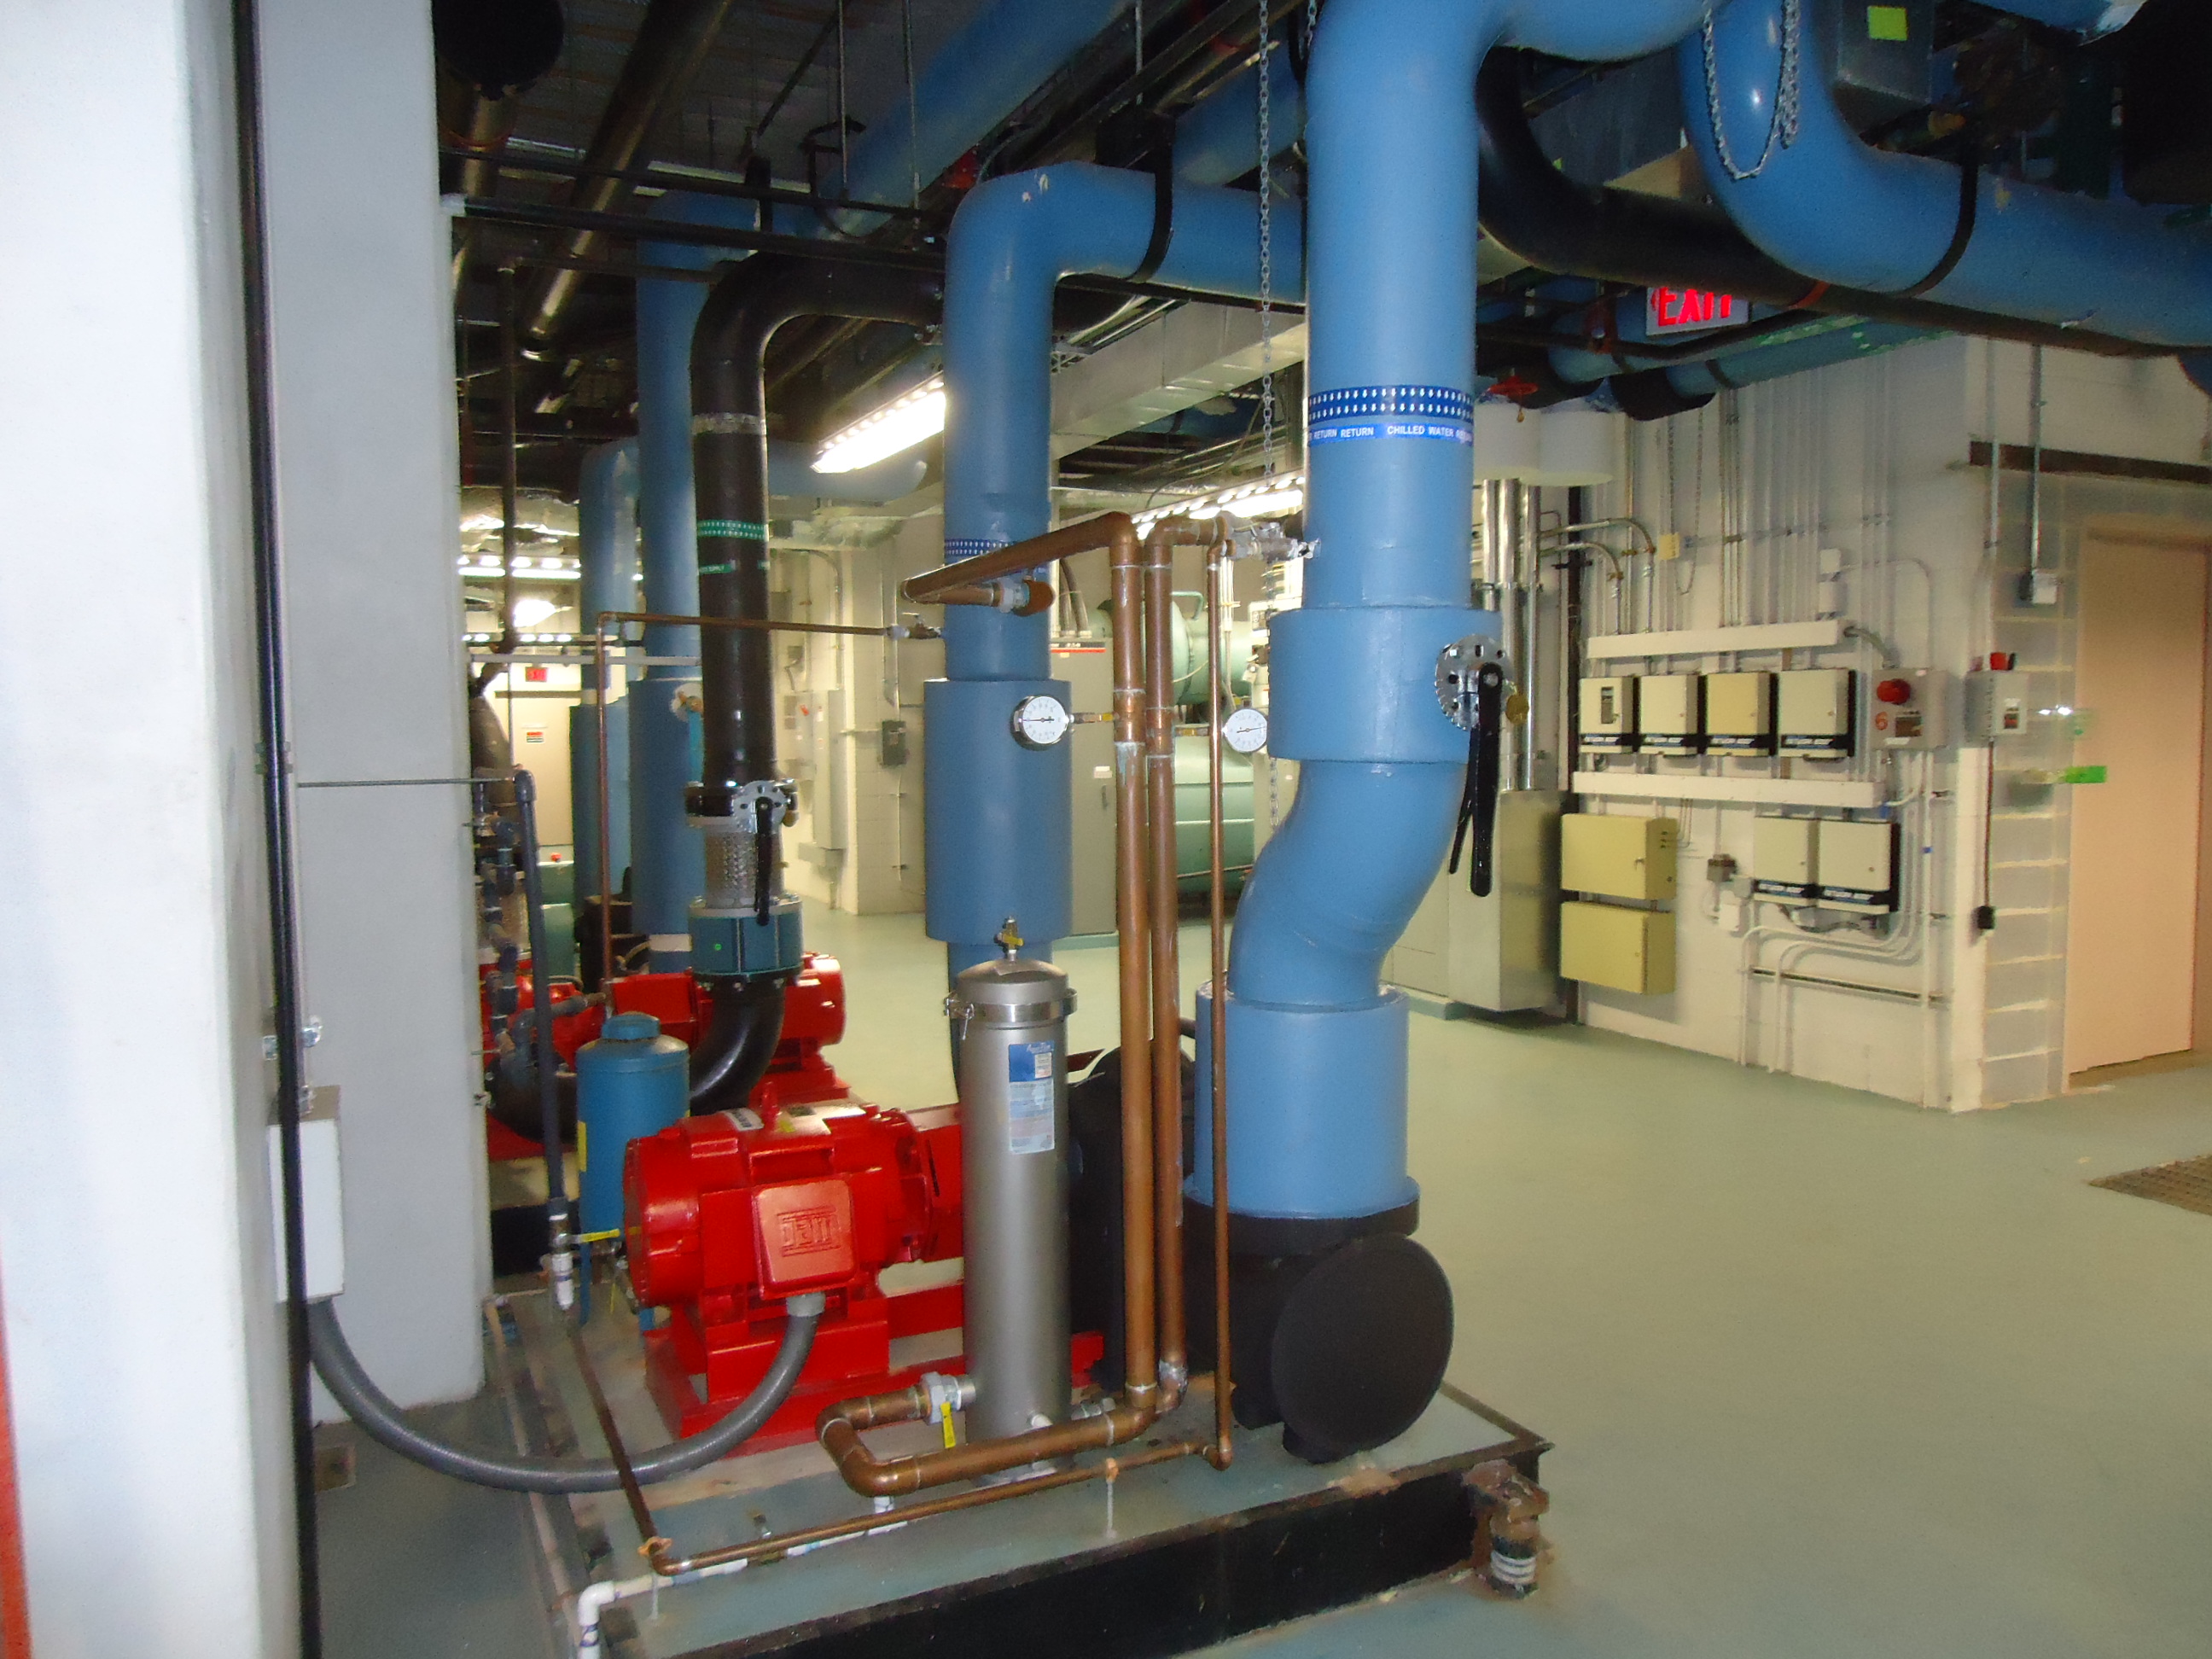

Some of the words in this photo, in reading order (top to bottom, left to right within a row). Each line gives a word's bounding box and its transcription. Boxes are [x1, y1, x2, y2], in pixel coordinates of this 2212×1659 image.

[1314, 429, 1337, 439] RETURN
[1341, 428, 1374, 438] RETURN
[1388, 426, 1425, 434] CHILLED
[1429, 427, 1454, 437] WATER
